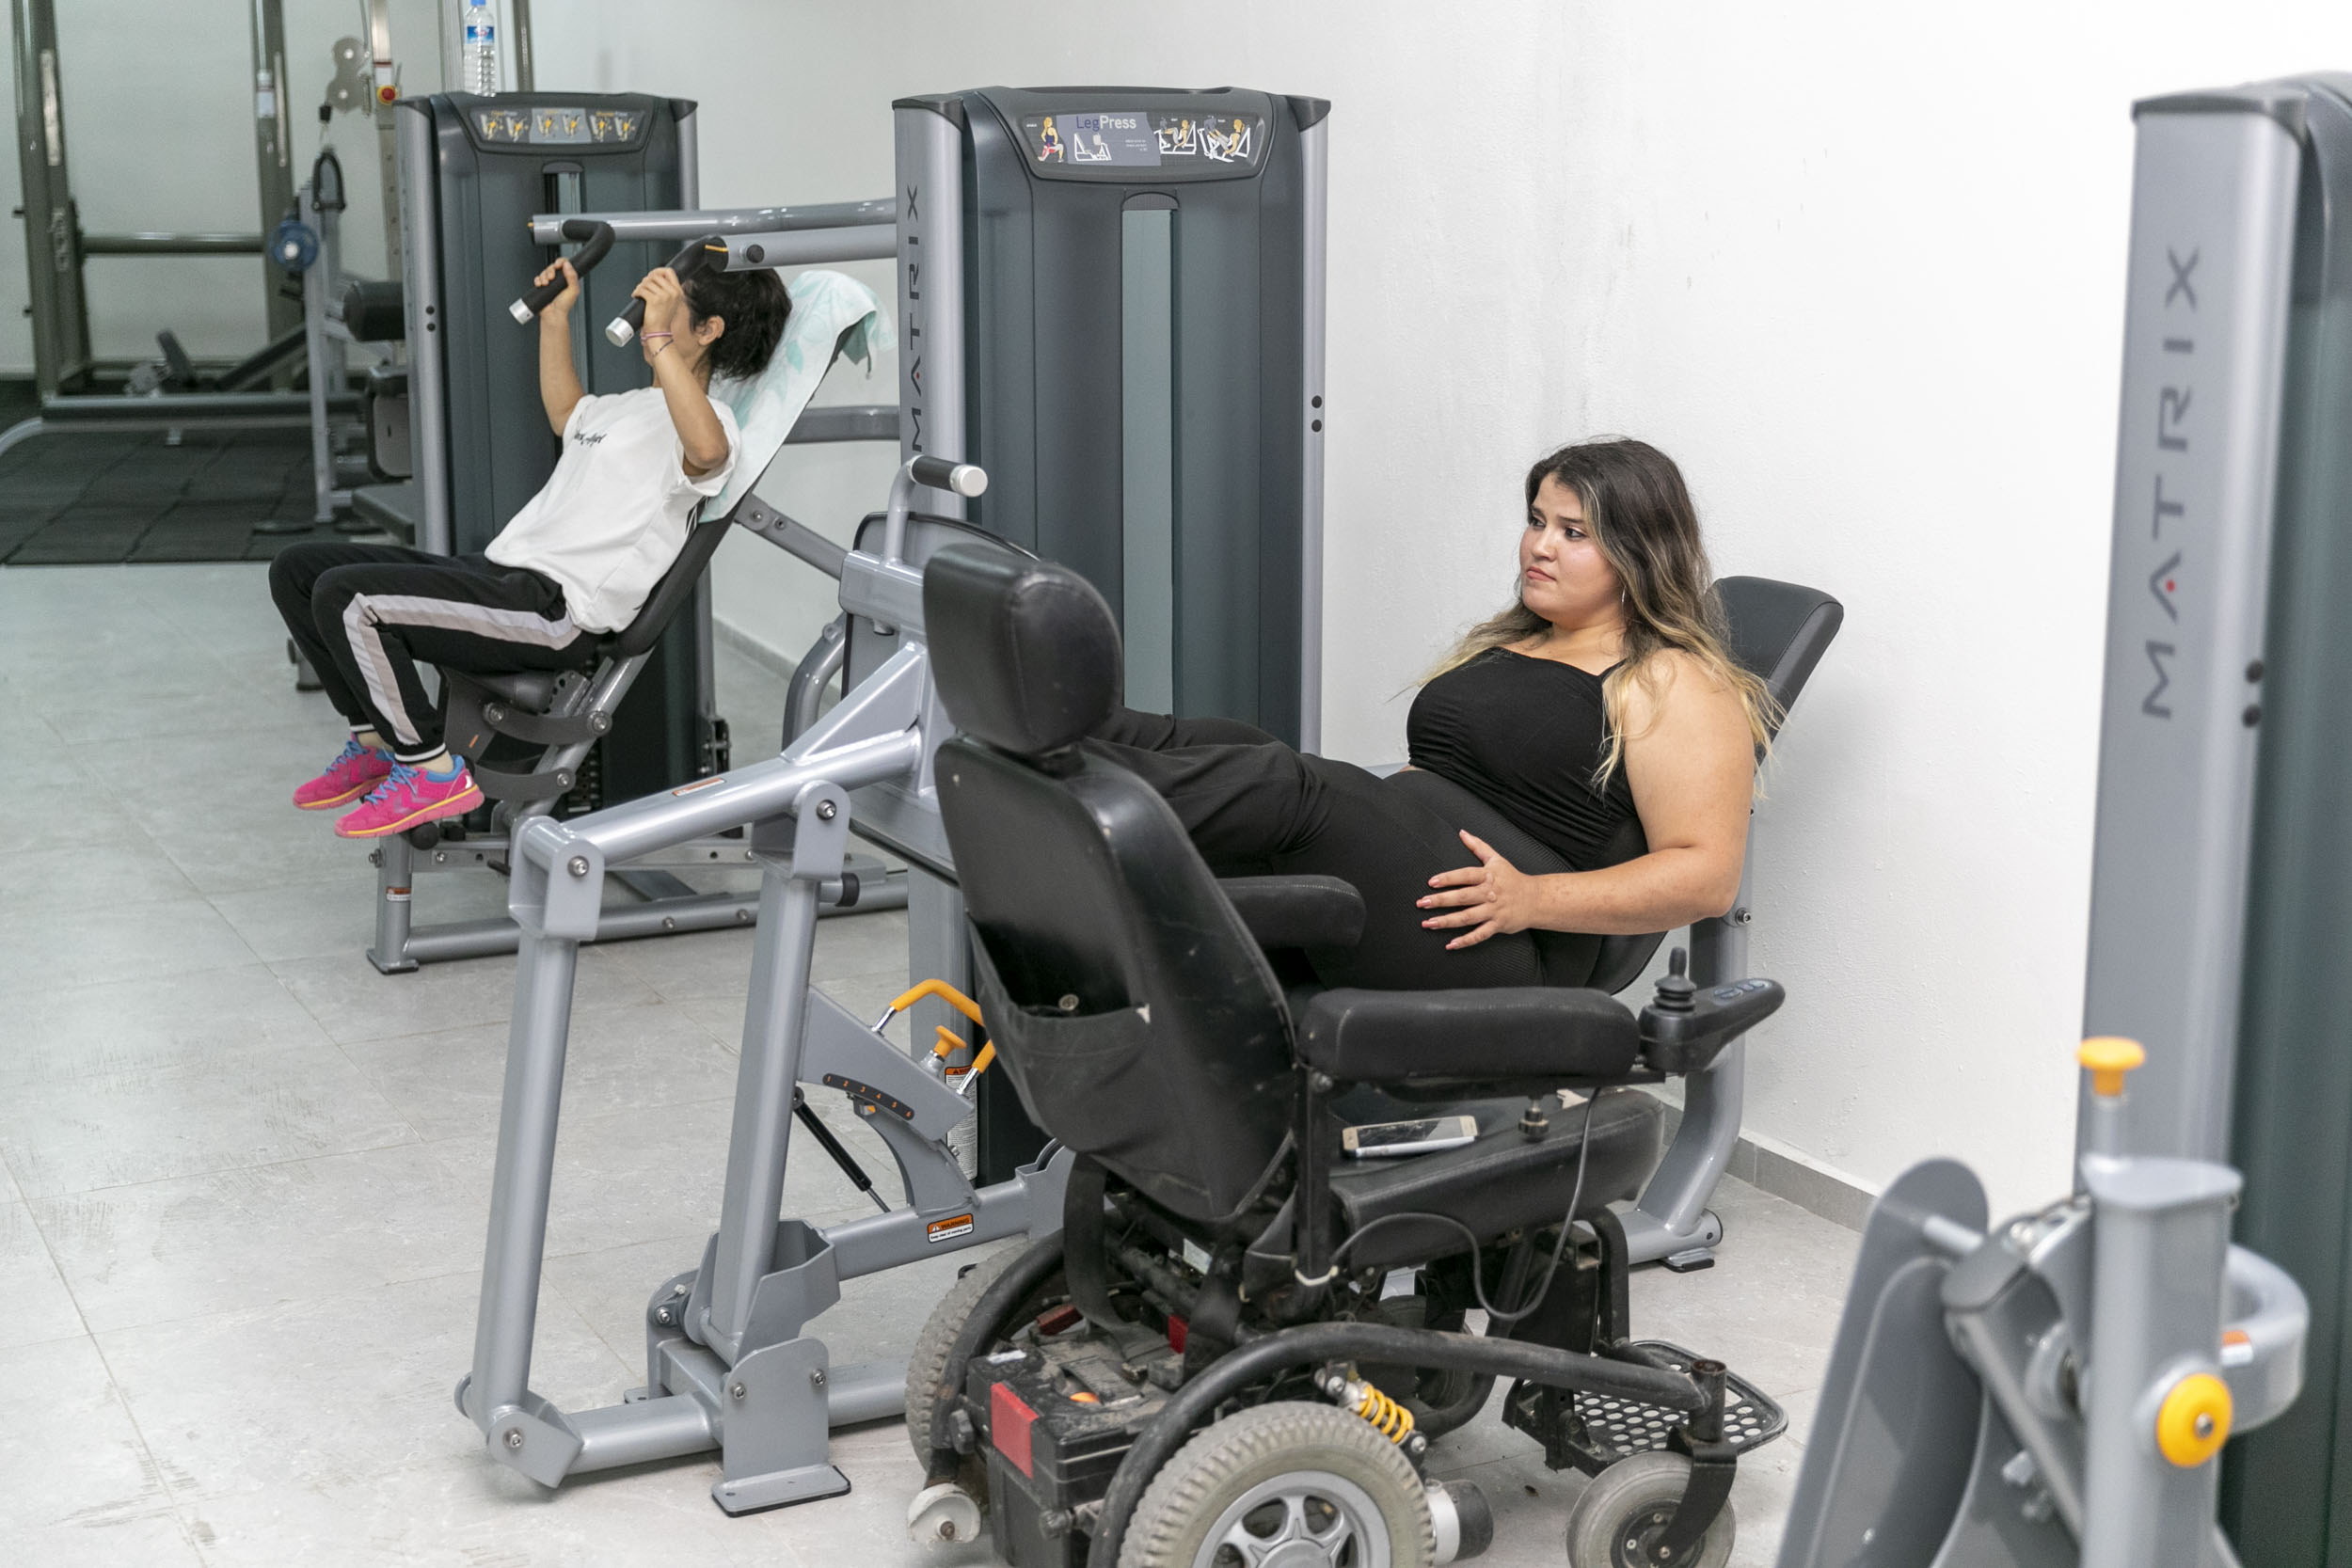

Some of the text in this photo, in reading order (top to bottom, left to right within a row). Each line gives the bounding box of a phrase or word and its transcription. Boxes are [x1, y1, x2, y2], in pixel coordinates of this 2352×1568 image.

[1076, 115, 1136, 132] LegPress
[907, 184, 922, 451] MATRIX
[2140, 245, 2201, 721] MATRIX
[941, 1217, 969, 1229] WARNING
